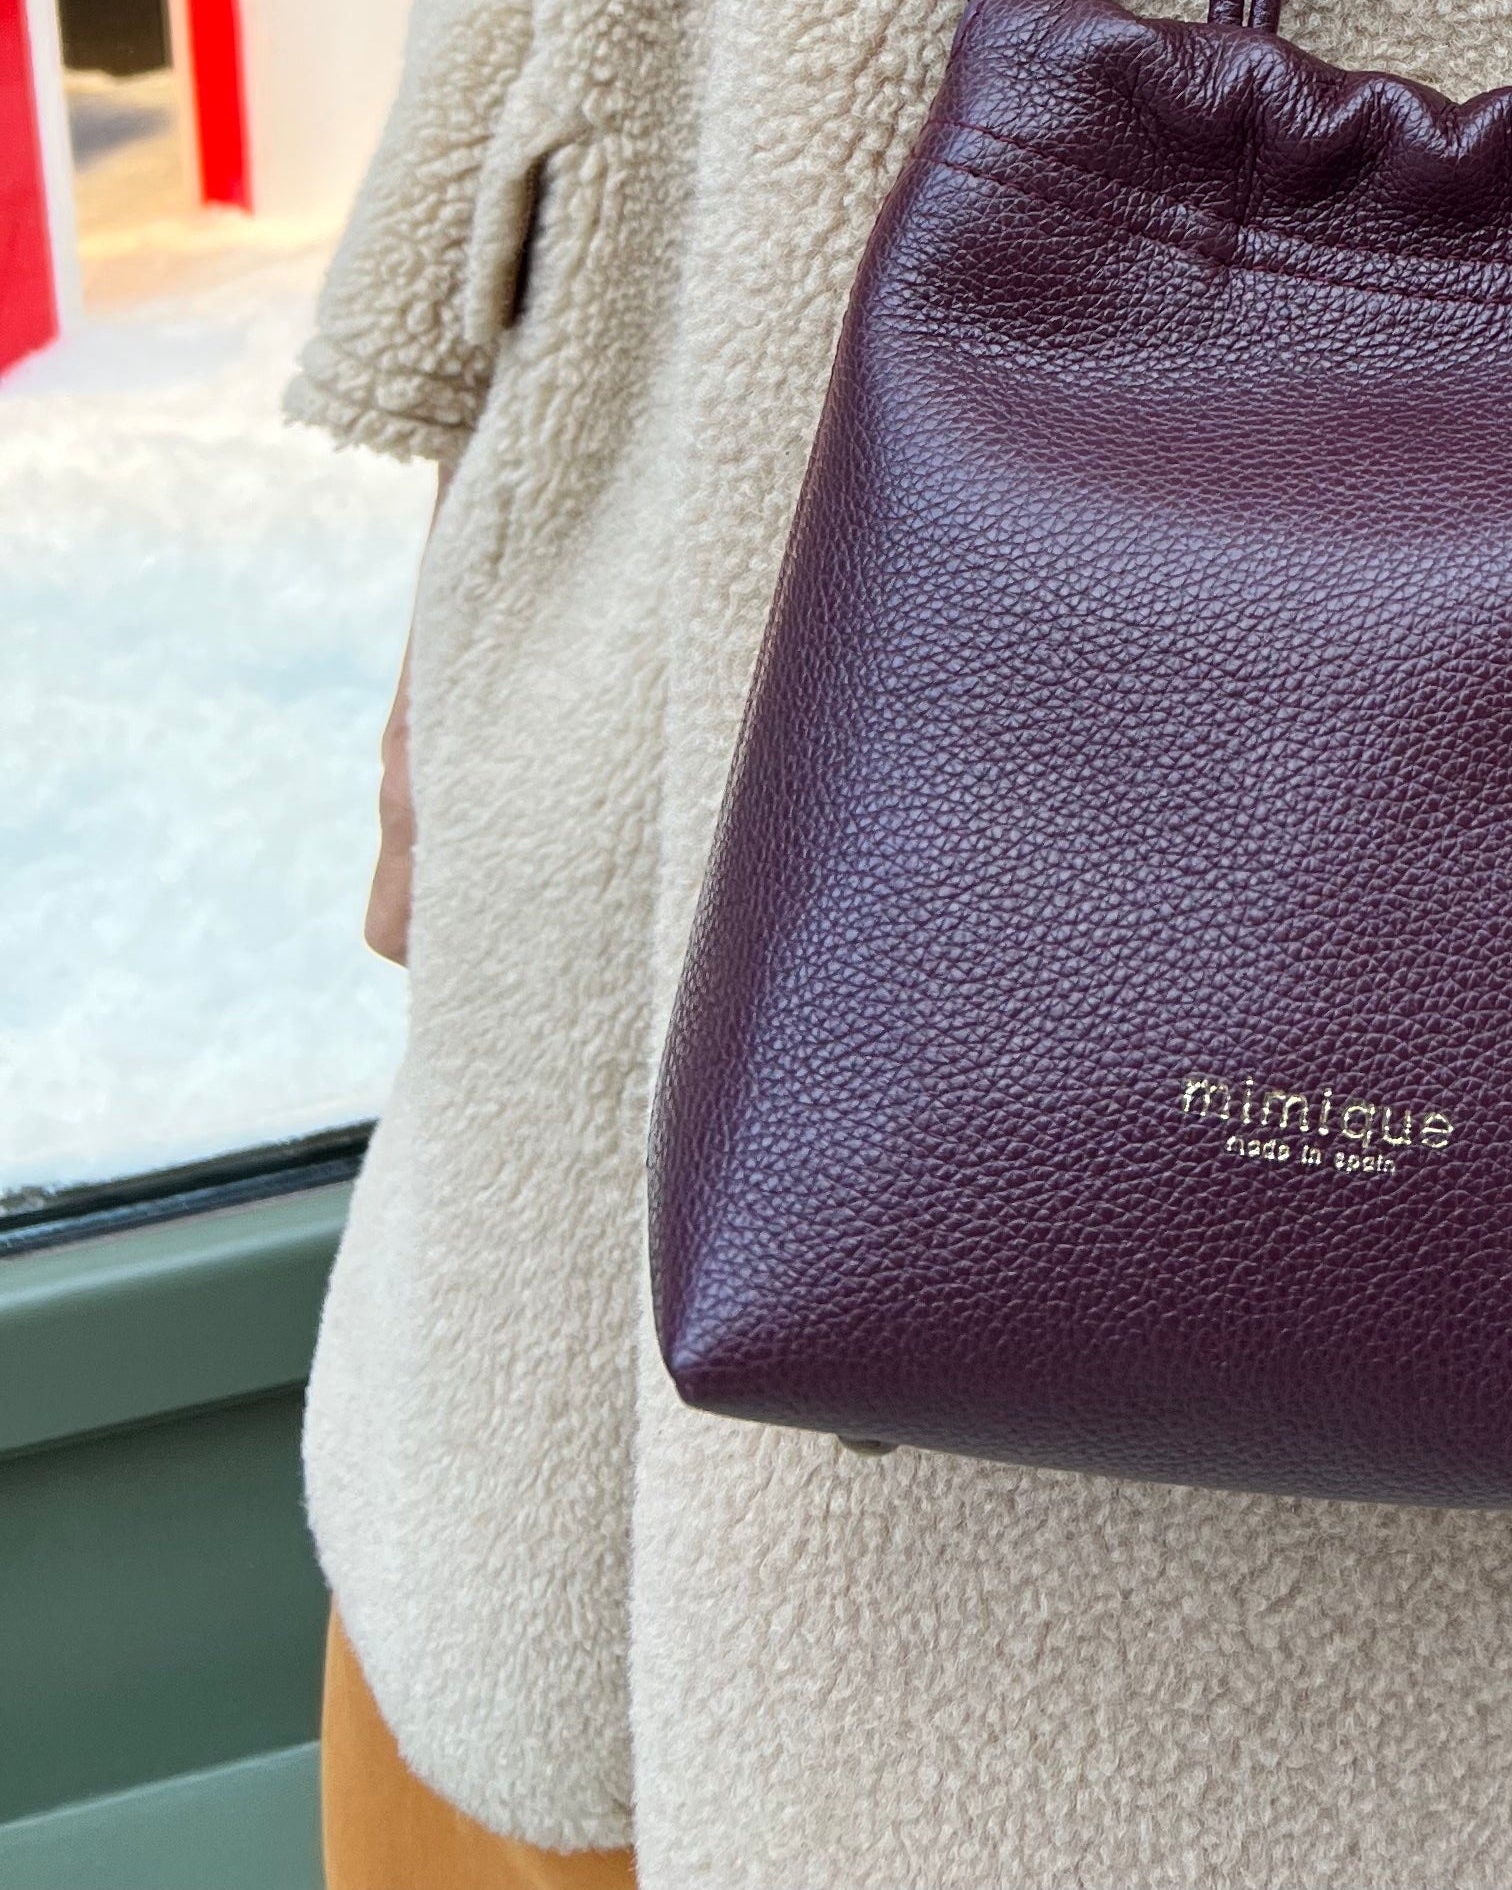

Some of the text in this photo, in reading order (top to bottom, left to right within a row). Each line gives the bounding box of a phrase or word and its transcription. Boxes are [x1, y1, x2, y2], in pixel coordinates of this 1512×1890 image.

[1182, 1076, 1454, 1148] mimique
[1225, 1135, 1396, 1174] made in spain
